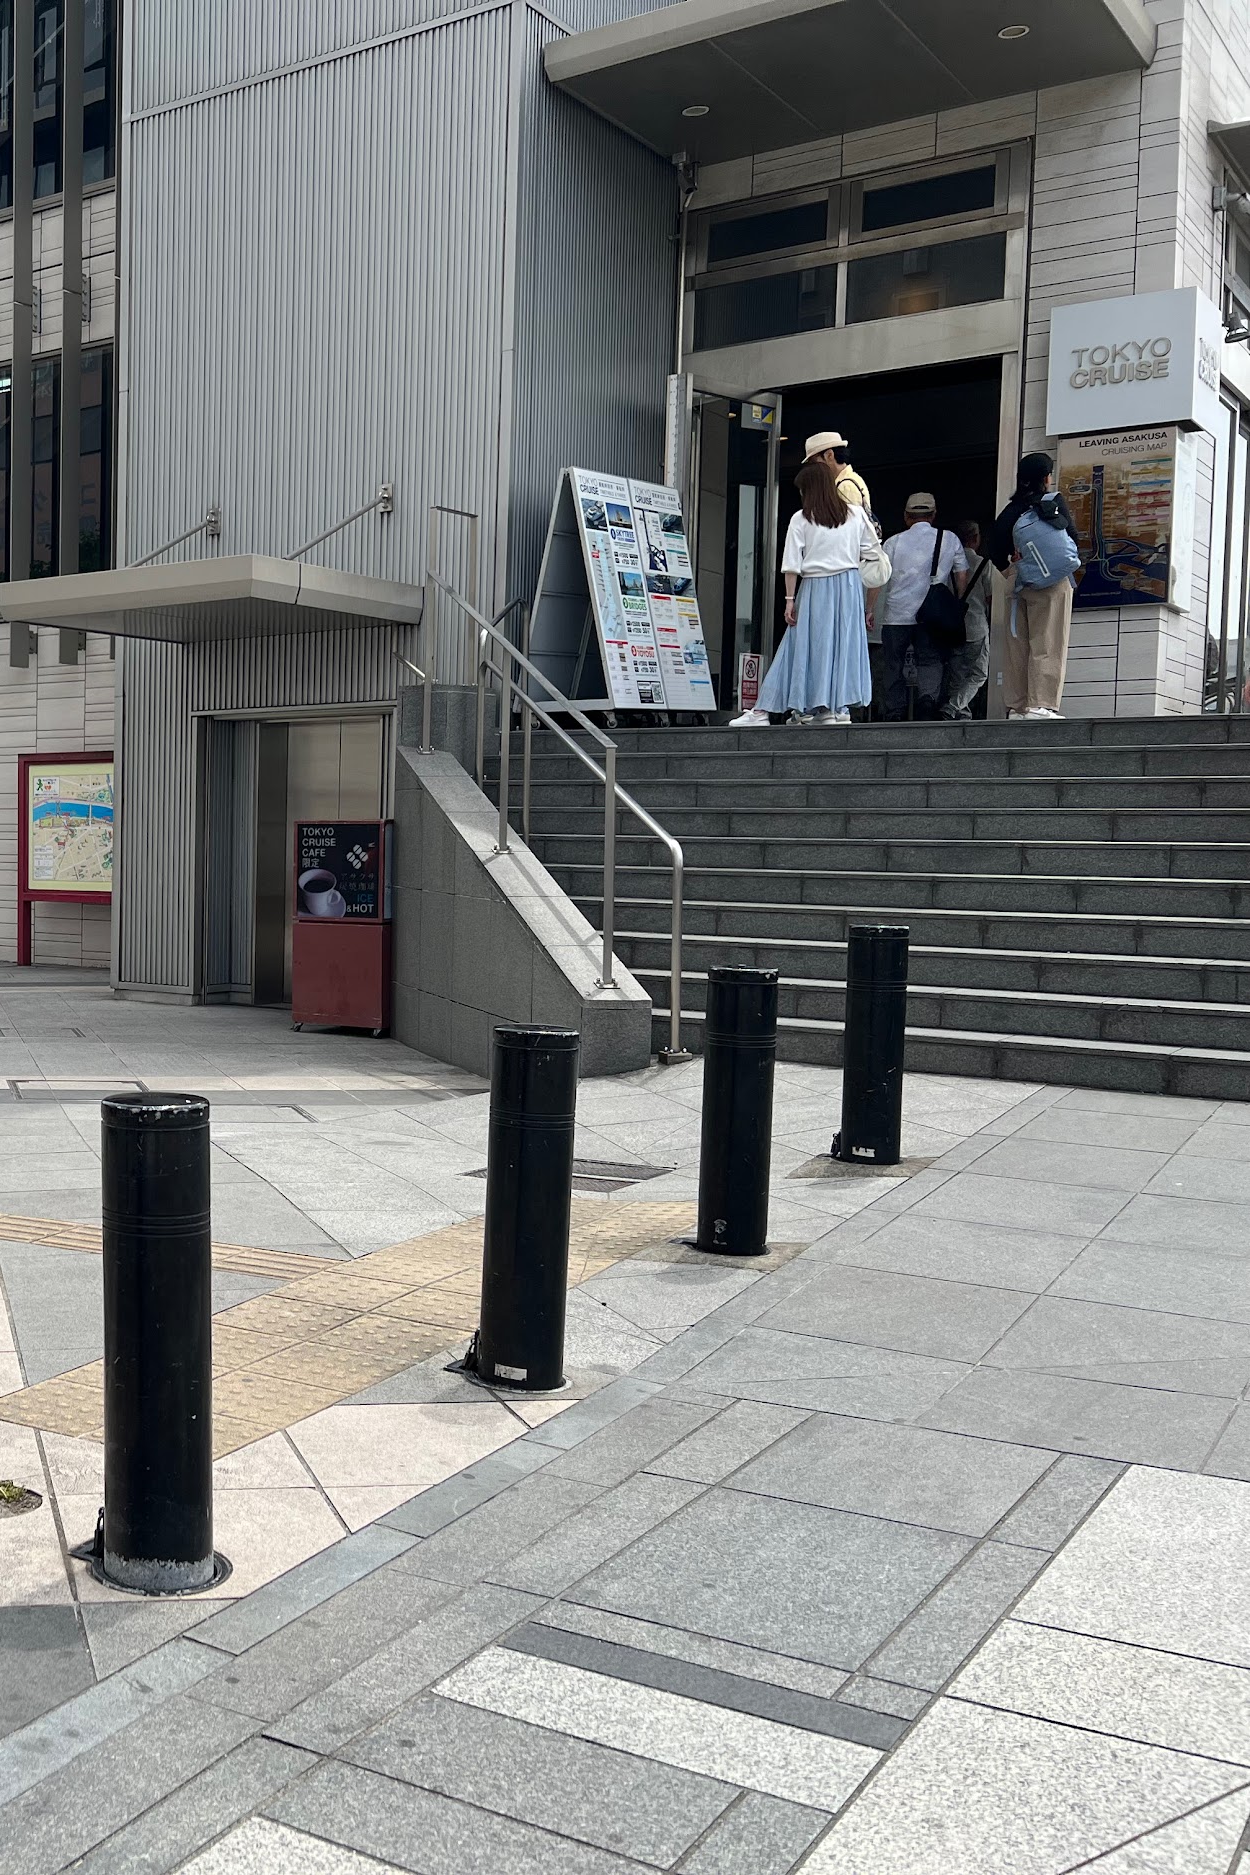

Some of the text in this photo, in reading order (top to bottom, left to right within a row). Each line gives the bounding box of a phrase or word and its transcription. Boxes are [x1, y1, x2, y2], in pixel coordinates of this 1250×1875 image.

[1070, 337, 1172, 368] TOKYO
[1069, 358, 1170, 389] CRUISE
[1079, 431, 1168, 448] LEAVING ASAKUSA
[1101, 442, 1168, 456] CRUISING MAP
[580, 484, 599, 496] CRUISE
[635, 495, 653, 506] CRUISE
[302, 827, 335, 836] TOKYO
[302, 838, 337, 847] CRUISE
[302, 848, 326, 857] CAFE
[301, 858, 320, 868] 限定
[357, 893, 374, 902] ICE
